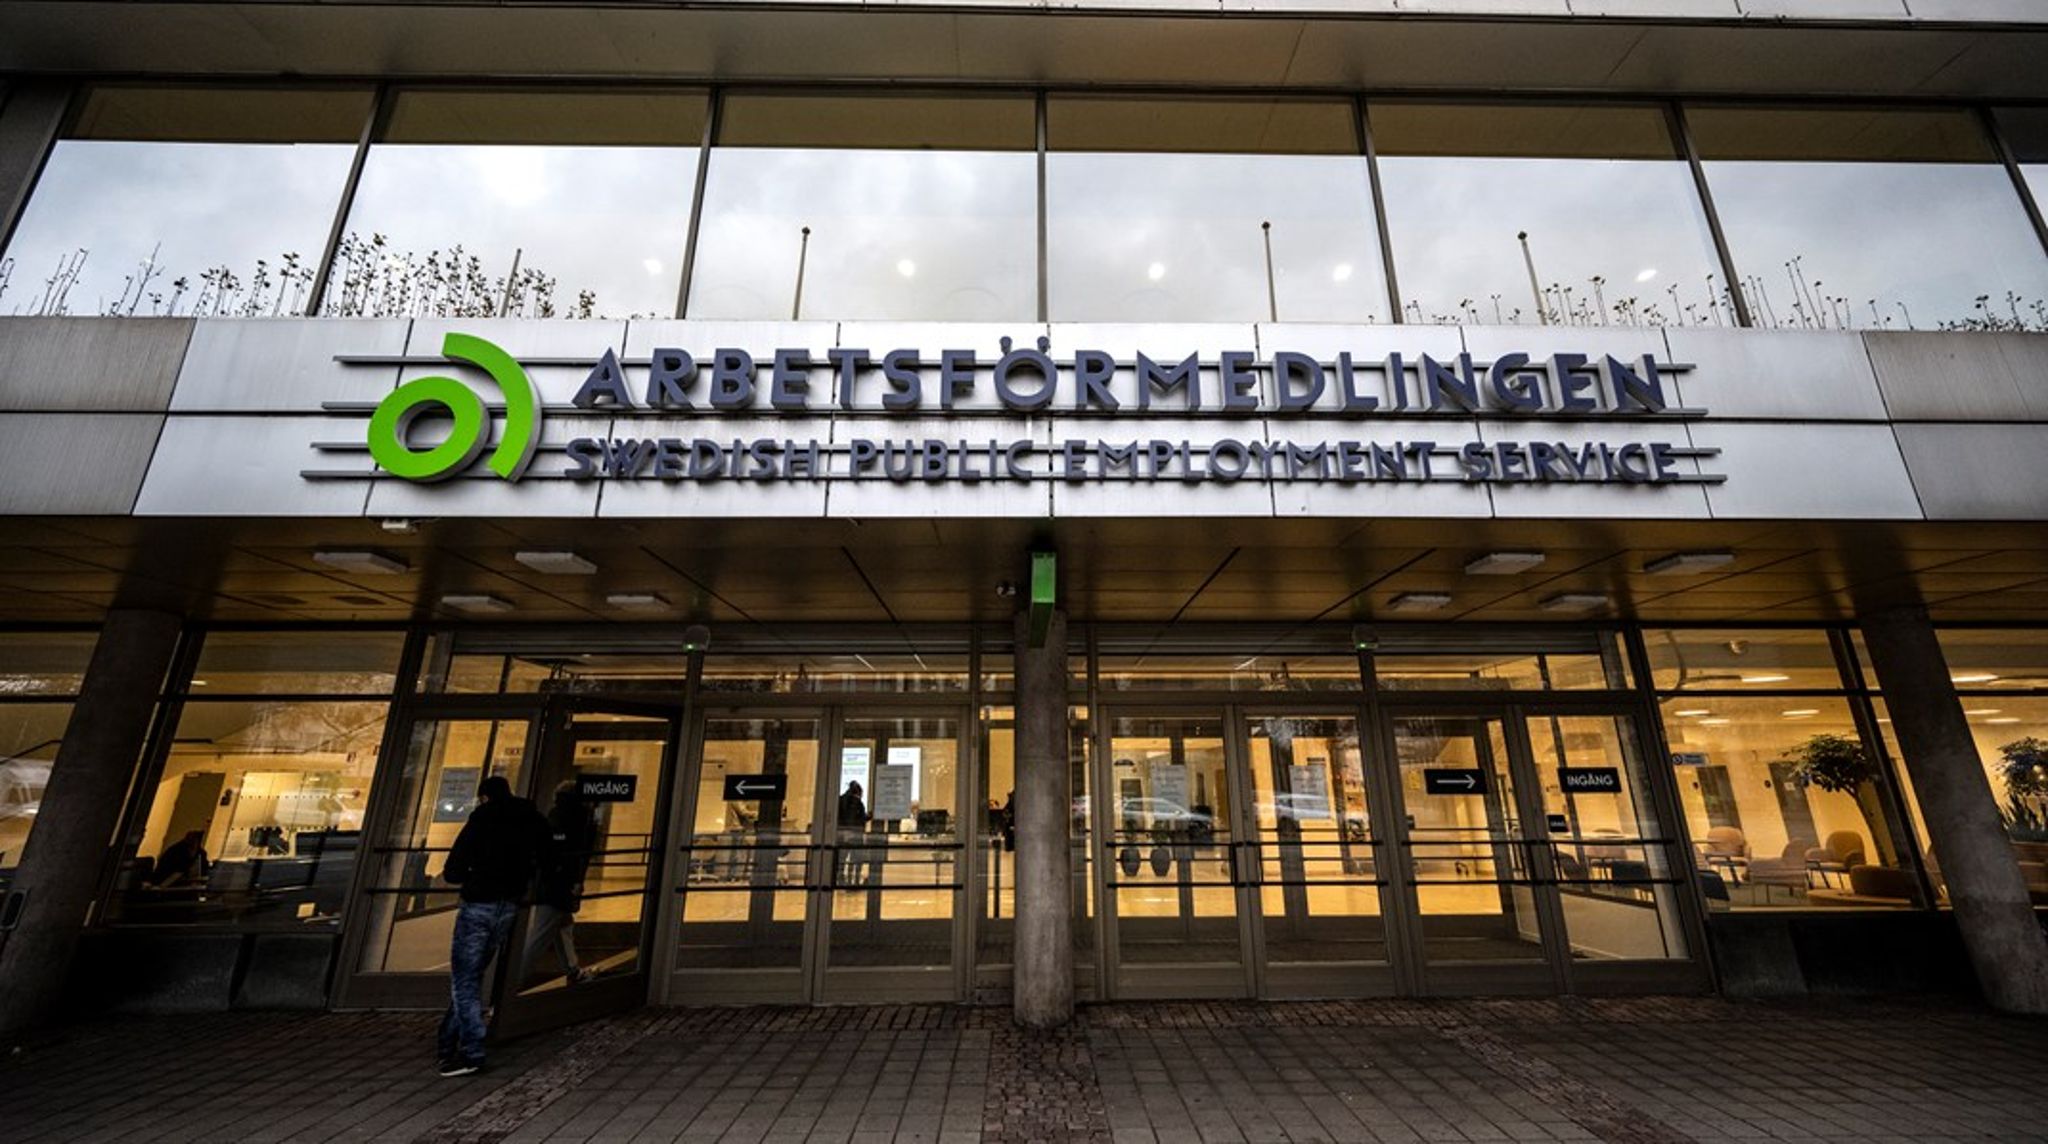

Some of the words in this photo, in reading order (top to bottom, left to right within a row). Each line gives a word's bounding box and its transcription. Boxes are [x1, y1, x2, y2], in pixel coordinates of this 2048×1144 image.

[571, 335, 1667, 413] ARBETSFÖRMEDLINGEN
[564, 437, 818, 480] SWEDISH
[850, 438, 1033, 482] PUBLIC
[1063, 438, 1436, 482] EMPLOYMENT
[1459, 441, 1679, 482] SERVICE
[583, 781, 630, 795] INGÅNG
[1566, 773, 1614, 786] INGÅNG
